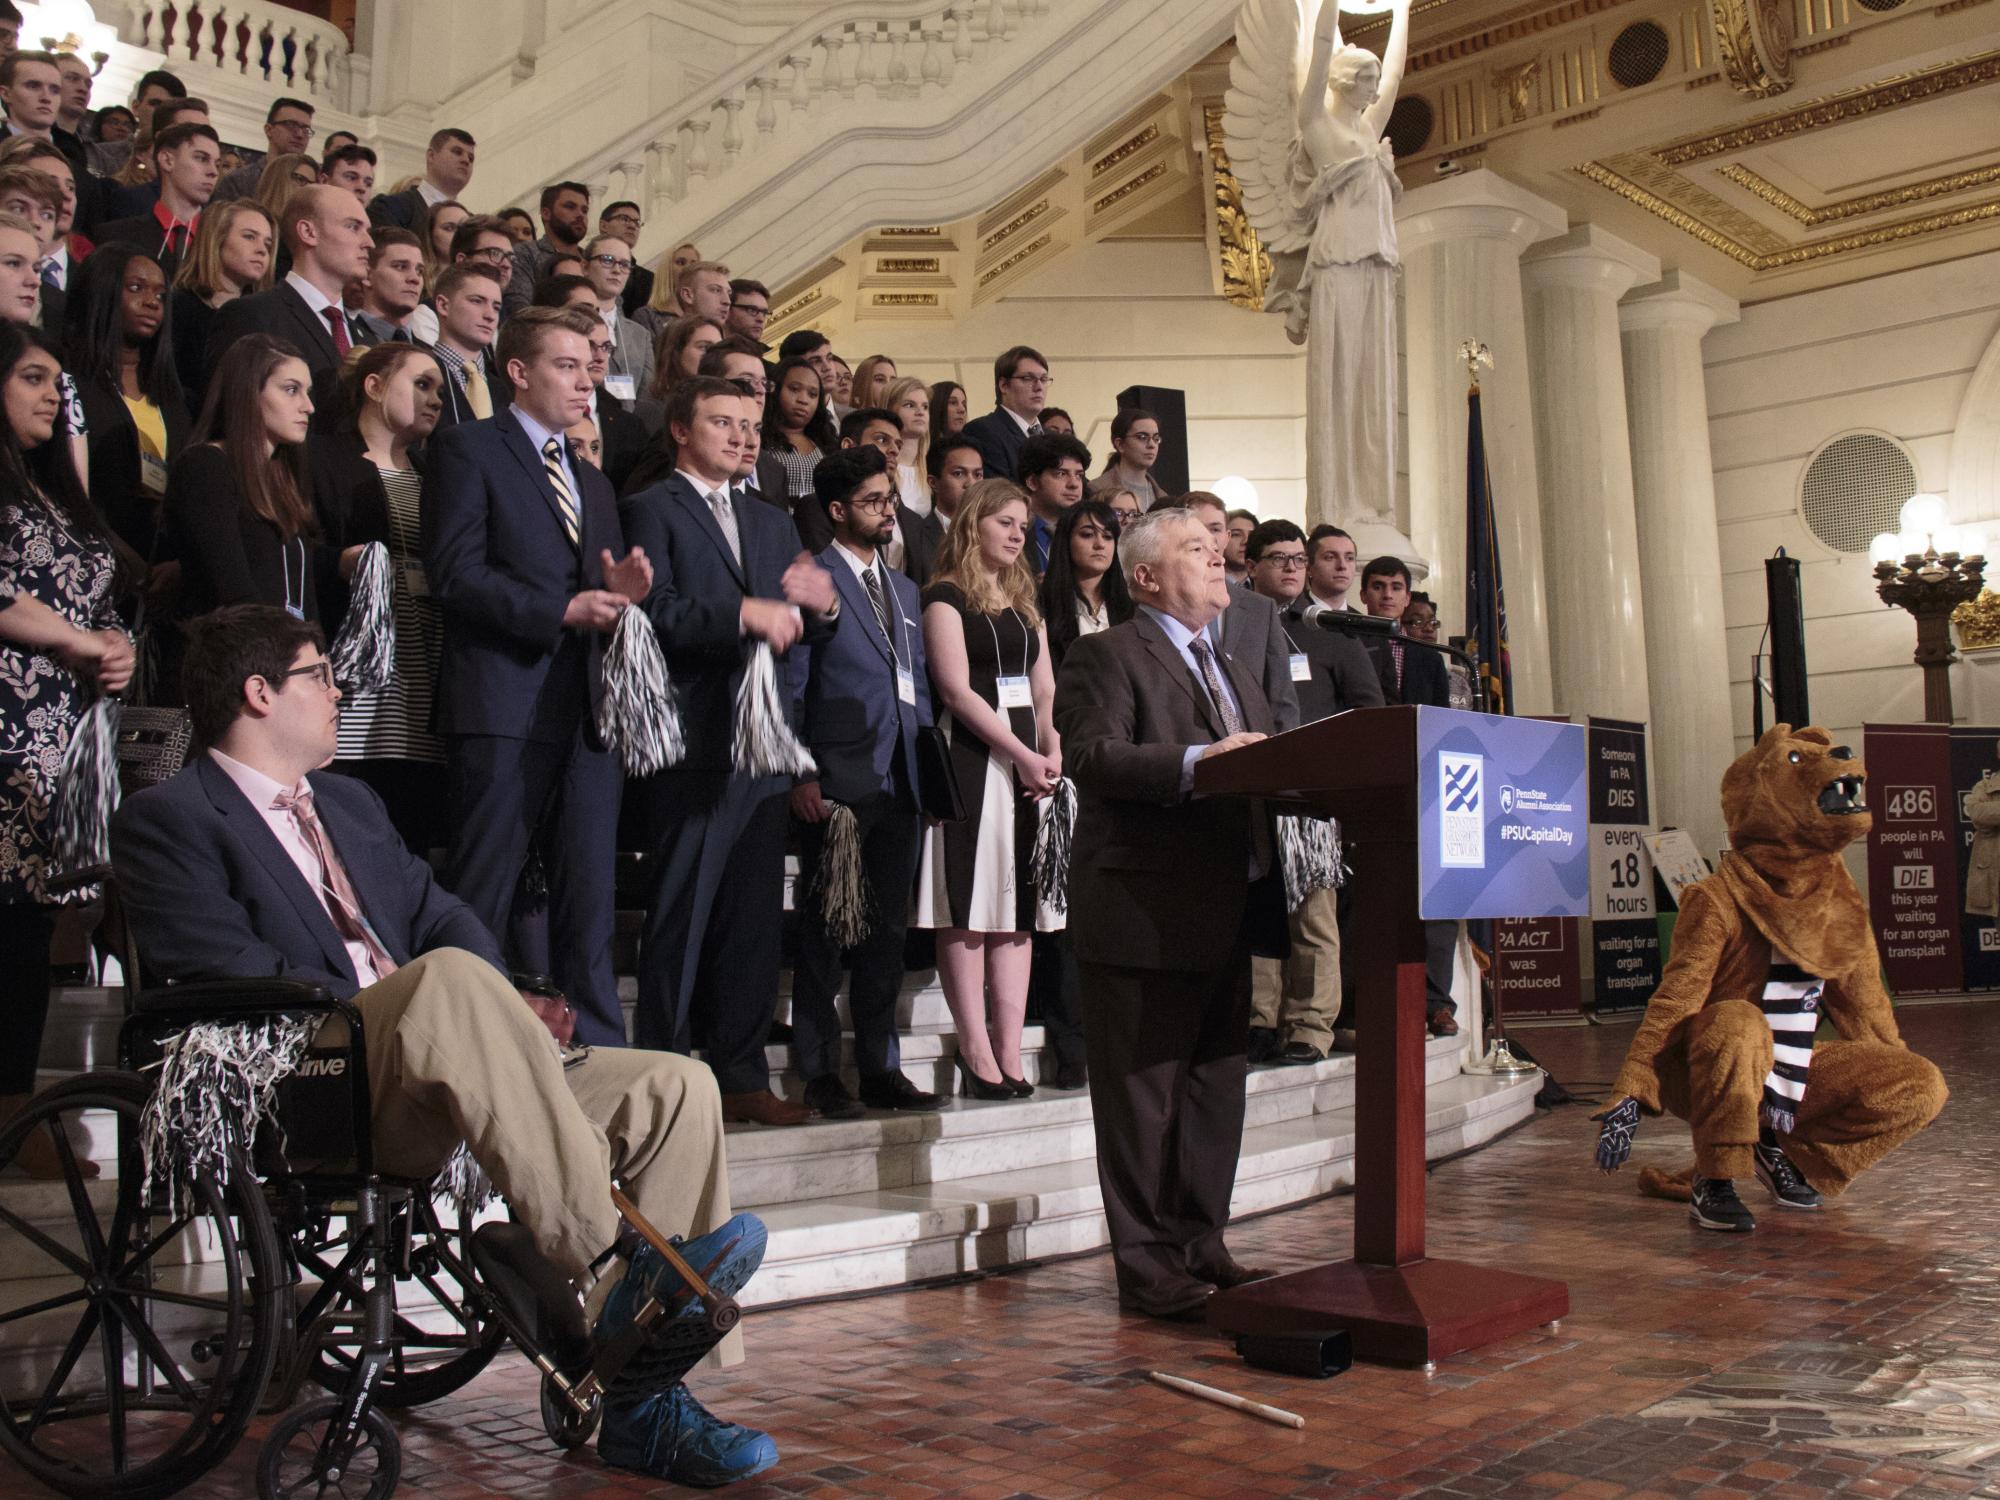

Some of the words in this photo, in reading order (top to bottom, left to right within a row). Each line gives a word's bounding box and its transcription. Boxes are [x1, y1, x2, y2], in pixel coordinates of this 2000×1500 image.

[1601, 747, 1636, 762] Someone
[1610, 766, 1619, 779] in
[1620, 767, 1631, 780] PA
[1608, 788, 1635, 807] DIES
[1888, 789, 1933, 818] 486
[1516, 800, 1538, 809] Alumni
[1539, 801, 1572, 812] Association
[1501, 825, 1573, 846] #PSUCapitalDay
[1605, 830, 1642, 851] every
[1880, 831, 1917, 845] people
[1919, 831, 1929, 841] in
[1931, 831, 1946, 841] PA
[1903, 847, 1924, 860] will
[1610, 852, 1640, 889] 18
[1901, 869, 1928, 887] DIE
[1606, 892, 1649, 914] hours
[1891, 893, 1913, 905] this
[1914, 894, 1939, 908] year
[1895, 910, 1937, 925] waiting
[1518, 931, 1551, 947] ACT
[1883, 928, 1899, 941] for
[1901, 929, 1915, 940] an
[1917, 929, 1951, 942] organ
[1600, 937, 1633, 953] waiting
[1634, 936, 1646, 949] for
[1647, 938, 1658, 949] an
[1888, 944, 1947, 960] transplant
[1509, 960, 1537, 971] was
[1616, 958, 1643, 972] organ
[1607, 974, 1655, 990] transplant
[363, 1361, 379, 1391] Silver
[351, 1391, 369, 1420] Sport
